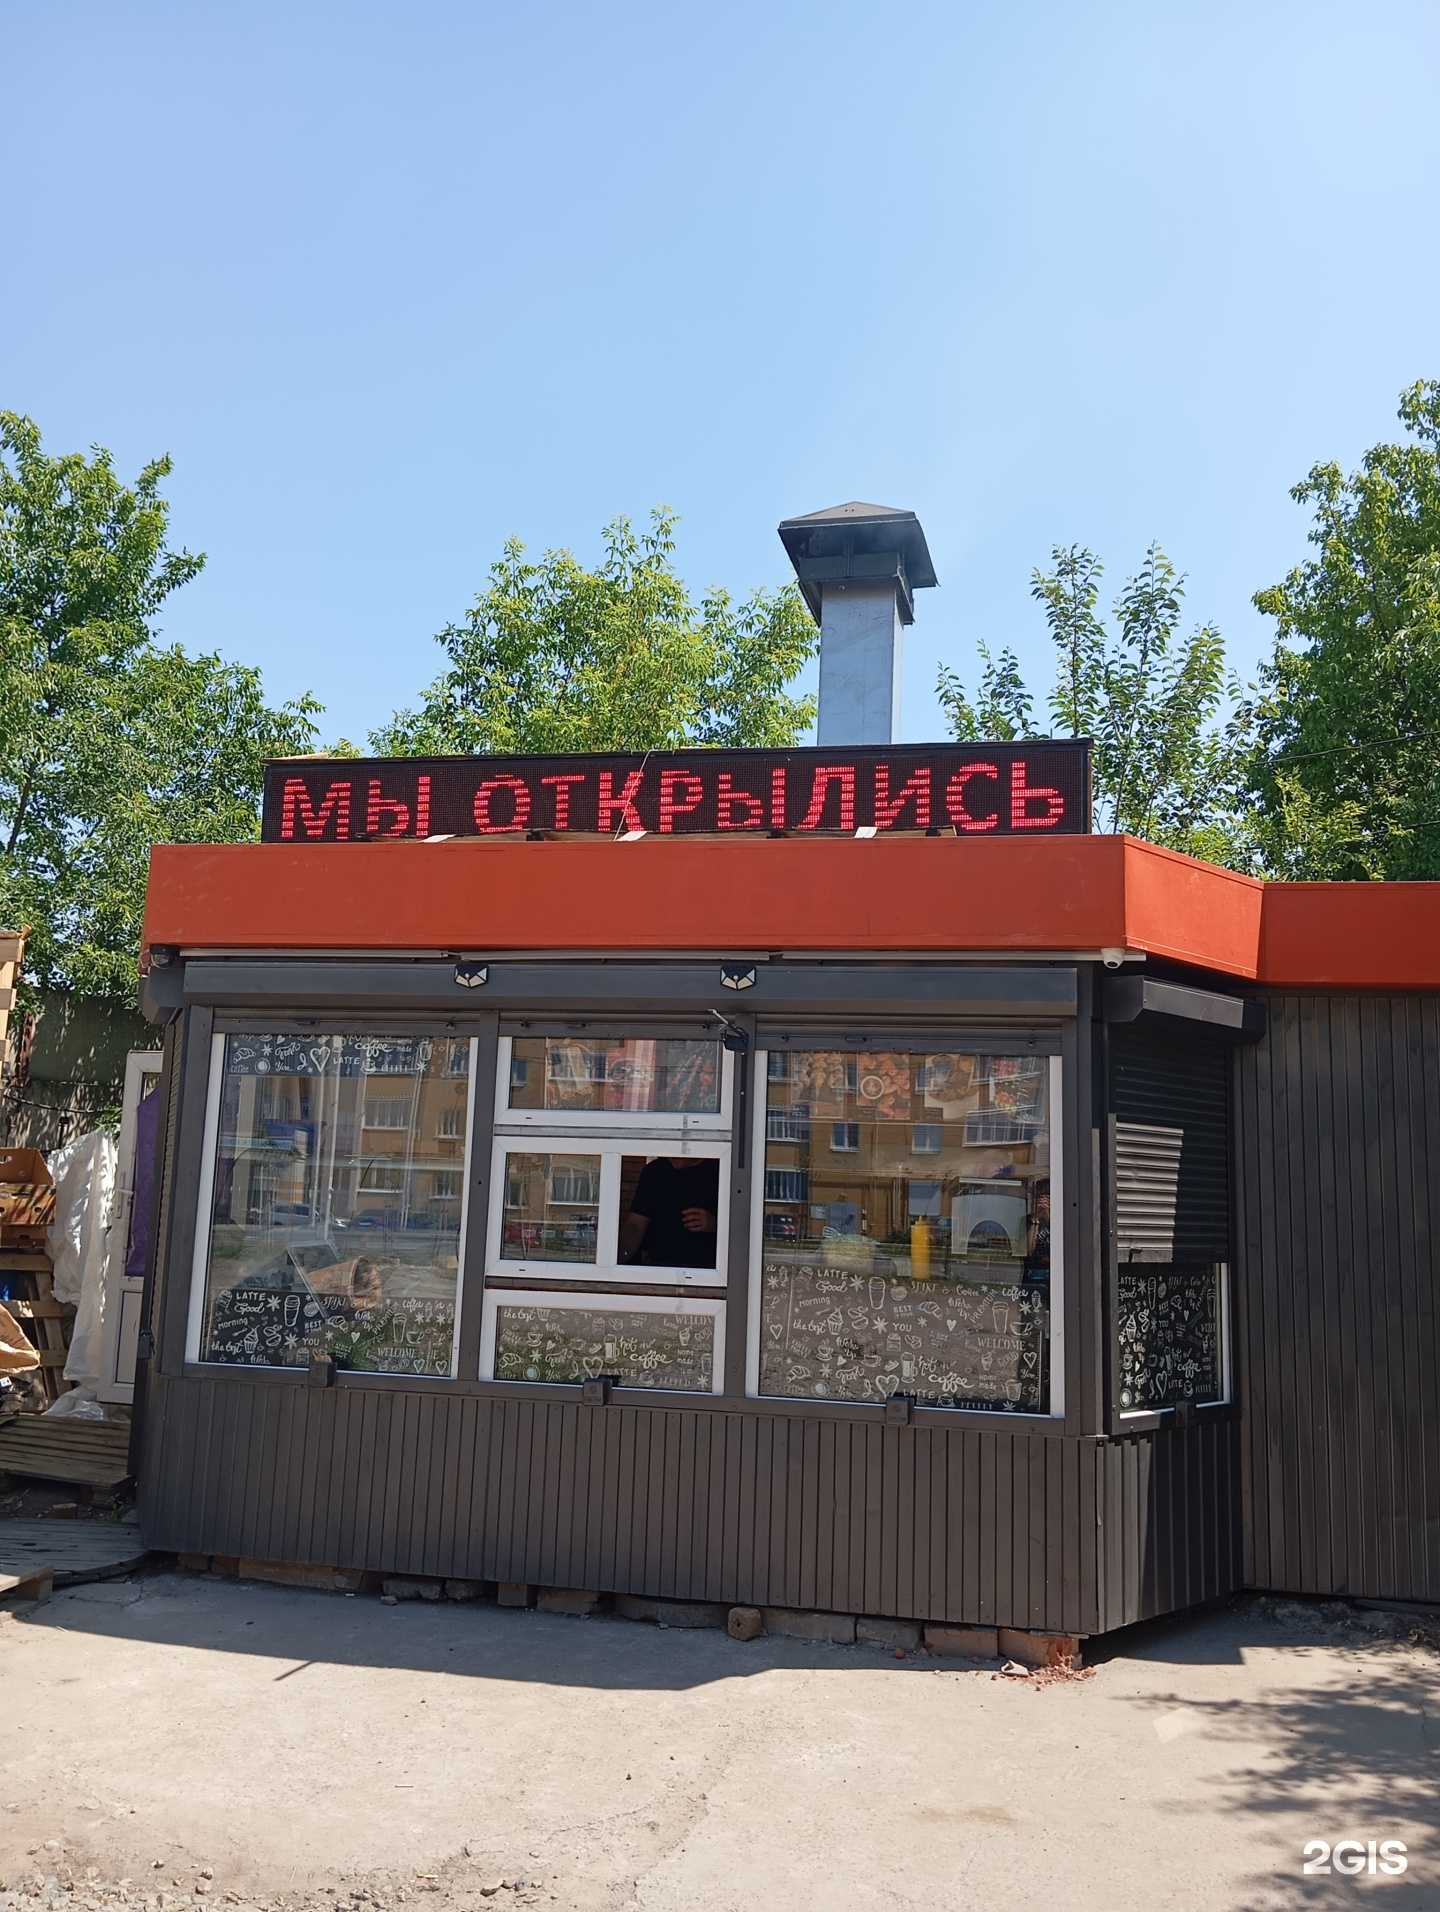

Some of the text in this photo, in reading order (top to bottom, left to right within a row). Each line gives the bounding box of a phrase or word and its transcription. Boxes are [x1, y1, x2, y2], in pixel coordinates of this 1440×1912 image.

[281, 762, 1064, 839] МЫ ОТКРЫЛИСЬ
[333, 1056, 361, 1065] LATTE
[817, 1269, 849, 1280] LATTE
[1119, 1276, 1137, 1286] ATTE
[816, 1280, 848, 1294] Good
[236, 1291, 267, 1301] LATTE
[234, 1302, 265, 1315] Good
[892, 1322, 913, 1332] YOU
[303, 1337, 320, 1347] YOU
[977, 1337, 1027, 1351] WELCOME
[630, 1349, 674, 1370] coffee
[607, 1367, 638, 1377] LATTE
[928, 1372, 976, 1393] coffee
[903, 1388, 936, 1399] LATTE
